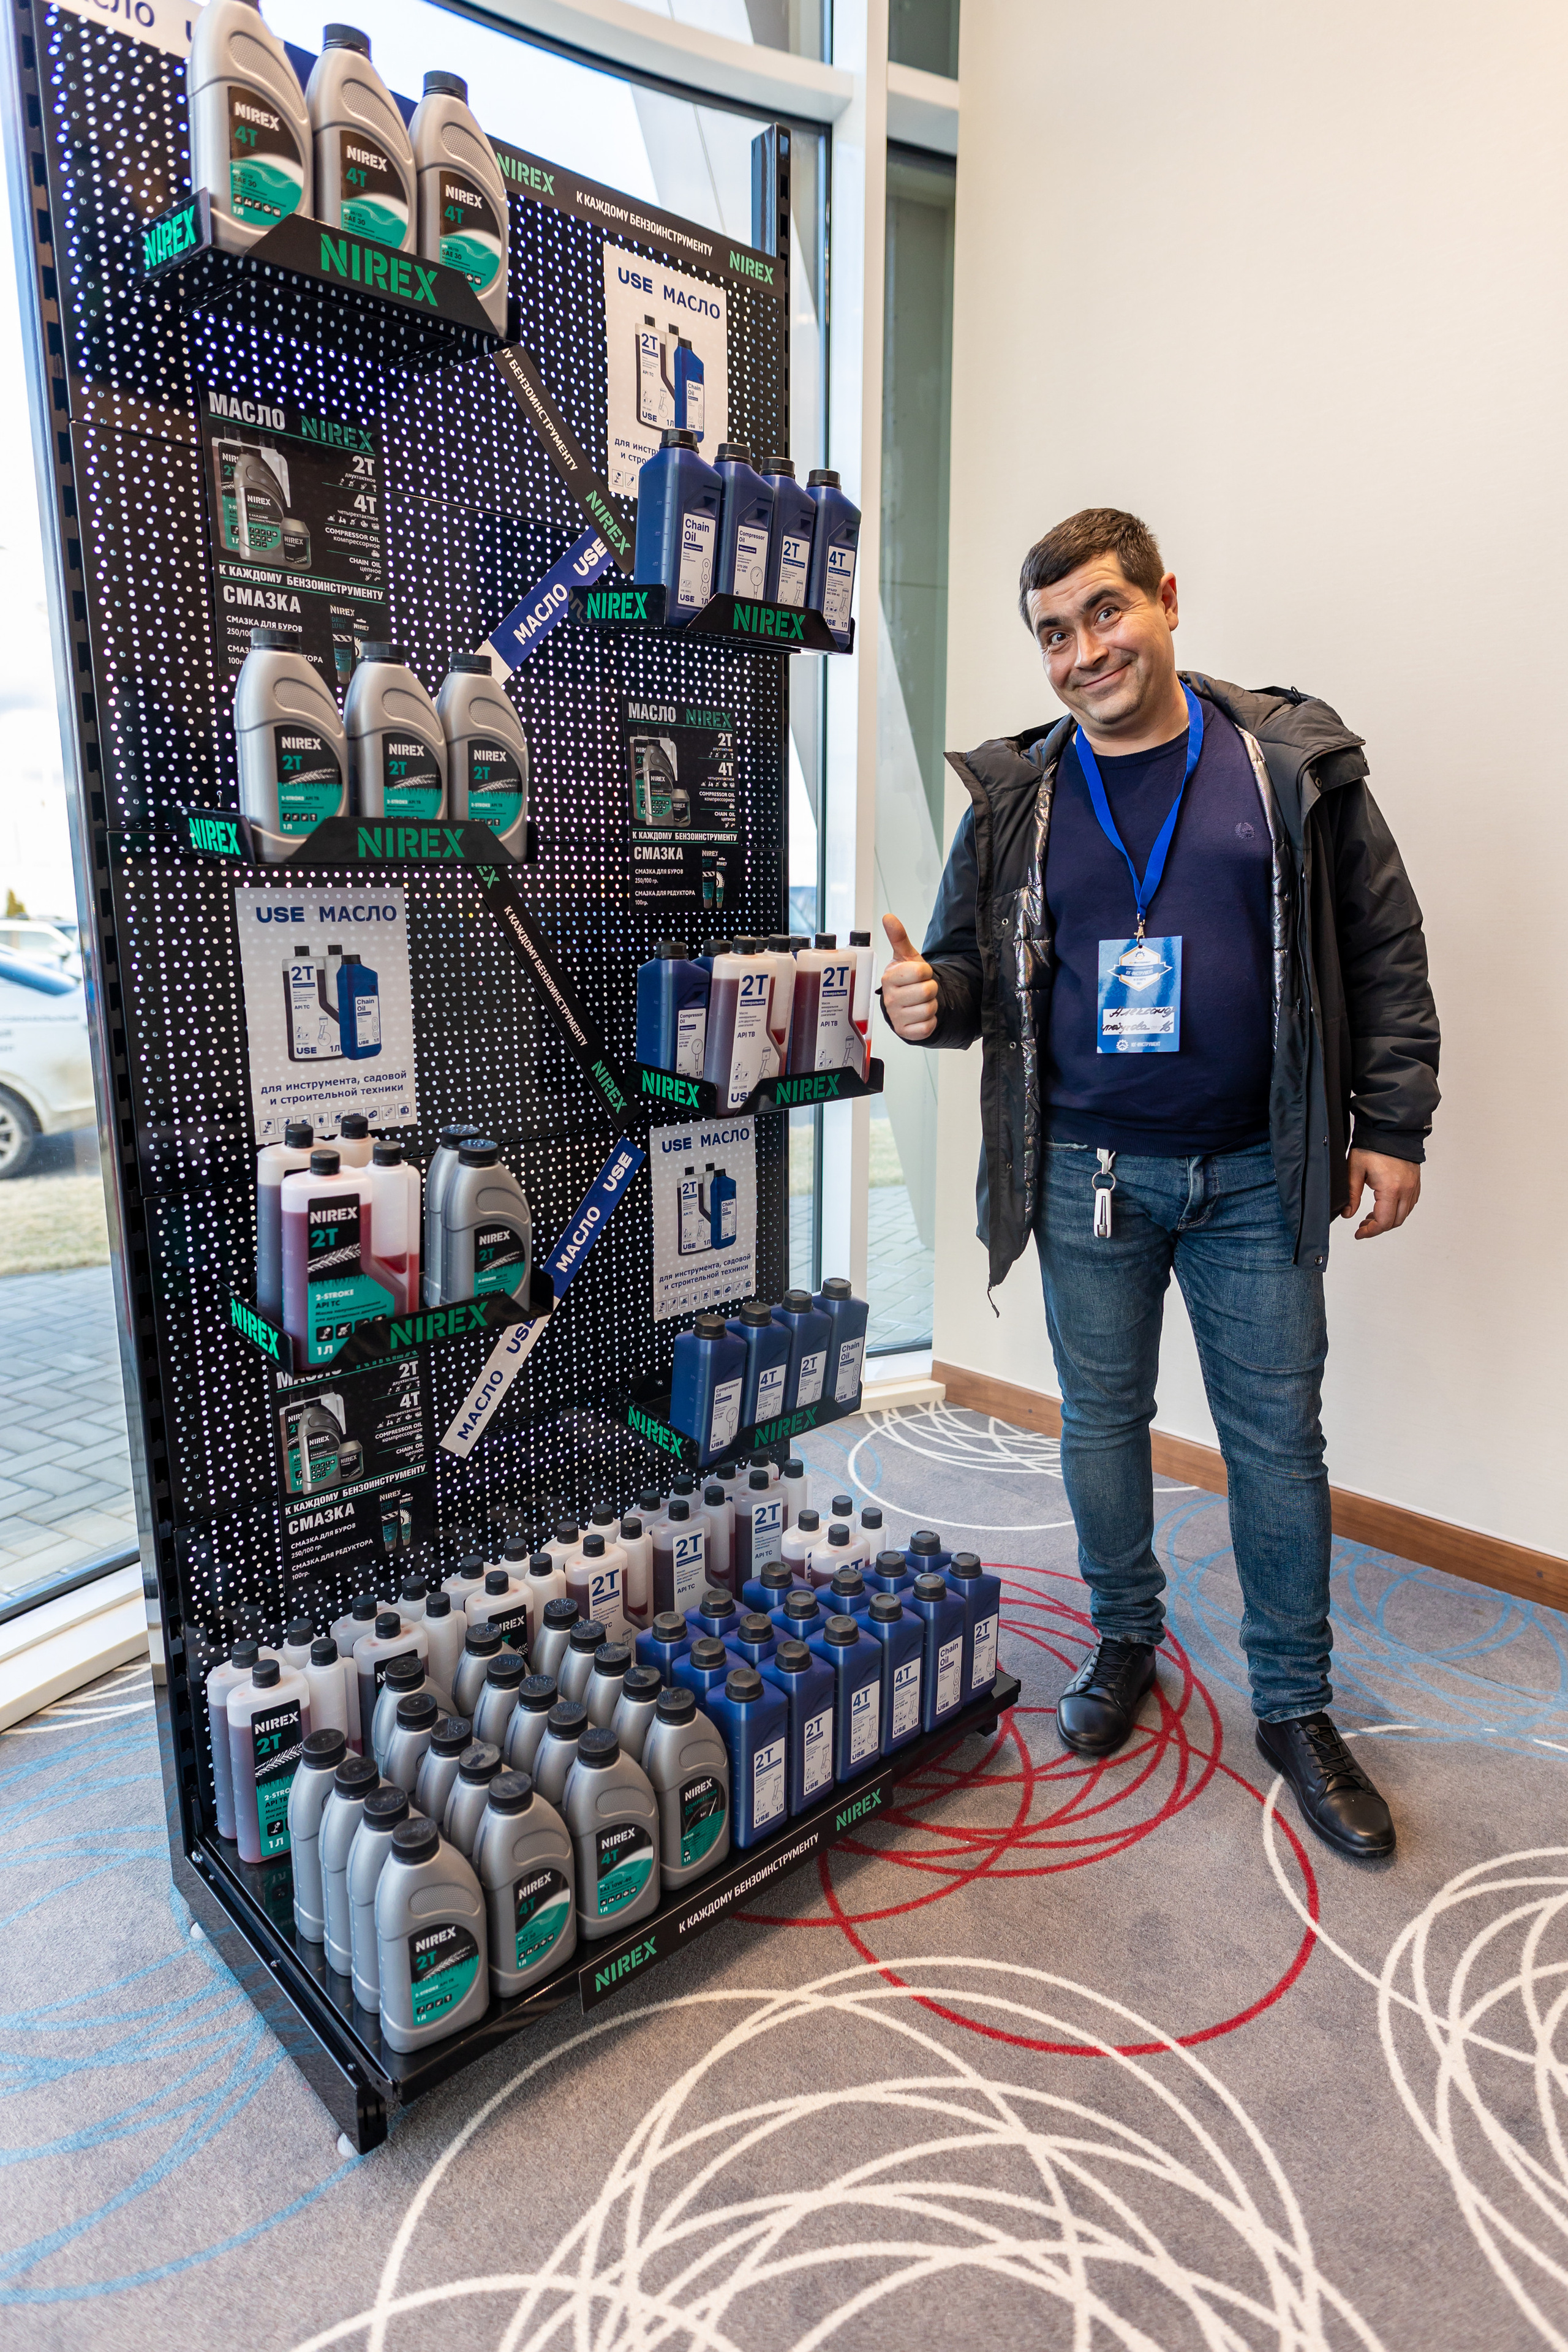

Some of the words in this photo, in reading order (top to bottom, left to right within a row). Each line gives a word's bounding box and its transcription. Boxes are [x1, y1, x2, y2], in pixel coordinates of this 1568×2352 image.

[235, 102, 279, 131] NIREX
[235, 125, 258, 147] 4T
[346, 145, 387, 172] NIREX
[346, 167, 367, 187] 4T
[497, 151, 554, 196] NIREX
[445, 184, 482, 209] NIREX
[444, 205, 464, 224] 4T
[576, 190, 582, 203] К
[584, 194, 628, 222] КАЖДОМУ
[630, 213, 712, 257] БЕНЗОИНСТРУМЕНТУ
[145, 205, 195, 270] NIREX
[321, 234, 437, 306] NIREX
[729, 249, 774, 285] NIREX
[618, 266, 653, 294] USE
[663, 284, 720, 319] МАСЛО
[688, 383, 701, 391] Chain
[209, 391, 285, 430] МАСЛО
[301, 415, 374, 453] NIREX
[508, 359, 578, 471] БЕНЗОИНСТРУМЕНТУ
[352, 456, 375, 475] 2T
[337, 509, 379, 521] четырехтактное
[354, 494, 377, 514] 4T
[585, 490, 631, 556] NIREX
[685, 519, 709, 532] Chain
[739, 530, 765, 540] Compressor
[783, 541, 800, 558] 2T
[829, 551, 846, 567] 4T
[349, 557, 369, 566] CHAIN
[360, 565, 382, 575] цепное
[219, 564, 226, 575] К
[229, 565, 282, 583] КАЖДОМУ
[287, 576, 383, 600] БЕНЗОИНСТРУМЕНТУ
[223, 585, 301, 613] СМАЗКА
[587, 592, 648, 619] NIREX
[733, 603, 805, 640] NIREX
[628, 702, 676, 723] МАСЛО
[686, 709, 733, 728] NIREX
[282, 736, 322, 750] NIREX
[389, 744, 424, 756] NIREX
[474, 750, 507, 762] NIREX
[189, 818, 241, 855] NIREX
[358, 827, 465, 858] NIREX
[639, 832, 672, 840] КАЖДОМУ
[675, 832, 737, 842] БЕНЗОИНСТРУМЕНТУ
[634, 846, 683, 860] СМАЗКА
[255, 906, 305, 923] USE
[319, 905, 397, 922] МАСЛО
[504, 905, 511, 914] К
[508, 910, 539, 960] КАЖДОМУ
[534, 959, 588, 1047] БЕНЗОИНСТРУМЕНТУ
[741, 974, 769, 997] 2T
[823, 967, 850, 987] 2T
[261, 1084, 282, 1095] для
[286, 1077, 361, 1091] инструмента,
[363, 1071, 407, 1084] садовой
[591, 1060, 627, 1114] NIREX
[642, 1070, 700, 1108] NIREX
[776, 1074, 841, 1105] NIREX
[281, 1089, 358, 1106] строительной
[360, 1084, 404, 1095] техники
[662, 1137, 693, 1153] USE
[701, 1128, 750, 1148] МАСЛО
[310, 1207, 358, 1224] NIREX
[556, 1206, 600, 1273] МАСЛО
[603, 1152, 633, 1192] USE
[311, 1227, 338, 1248] 2T
[479, 1230, 510, 1246] NIREX
[659, 1273, 673, 1283] для
[674, 1262, 722, 1278] инструмента,
[723, 1254, 751, 1267] садовой
[671, 1270, 719, 1290] строительной
[720, 1264, 748, 1276] техники
[231, 1298, 280, 1360] NIREX
[390, 1302, 488, 1349] NIREX
[841, 1352, 850, 1361] Oil
[399, 1360, 419, 1379] 2T
[399, 1391, 420, 1409] 4T
[385, 1406, 421, 1419] четырехтактное
[628, 1406, 683, 1460] NIREX
[755, 1406, 818, 1449] NIREX
[396, 1444, 413, 1455] CHAIN
[405, 1449, 424, 1457] цепное
[711, 1440, 723, 1449] USE
[340, 1455, 358, 1464] NIREX
[285, 1506, 292, 1516] К
[293, 1492, 339, 1514] КАЖДОМУ
[342, 1464, 426, 1498] БЕНЗОИНСТРУМЕНТУ
[288, 1502, 355, 1536] СМАЗКА
[755, 1502, 780, 1526] 2T
[292, 1558, 319, 1572] СМАЗКА
[320, 1551, 334, 1564] ДЛЯ
[335, 1539, 374, 1559] РЕДУКТОРА
[676, 1533, 702, 1559] 2T
[292, 1570, 310, 1580] 100гр.
[592, 1569, 619, 1597] 2T
[975, 1621, 990, 1638] 2T
[940, 1642, 959, 1657] Chain
[940, 1657, 949, 1666] Oil
[895, 1665, 911, 1683] 4T
[973, 1676, 984, 1686] USE
[853, 1688, 870, 1708] 4T
[255, 1711, 299, 1735] NIREX
[806, 1717, 823, 1739] 2T
[894, 1725, 906, 1735] USE
[256, 1733, 282, 1755] 2T
[756, 1747, 774, 1770] 2T
[685, 1777, 713, 1801] NIREX
[835, 1788, 882, 1832] NIREX
[601, 1827, 635, 1850] NIREX
[601, 1849, 619, 1864] 4T
[519, 1871, 551, 1899] NIREX
[679, 1921, 685, 1934] К
[687, 1890, 733, 1931] КАЖДОМУ
[734, 1832, 819, 1898] БЕНЗОИНСТРУМЕНТУ
[416, 1925, 456, 1953] NIREX
[417, 1950, 437, 1970] 2T
[595, 1936, 657, 1992] NIREX
